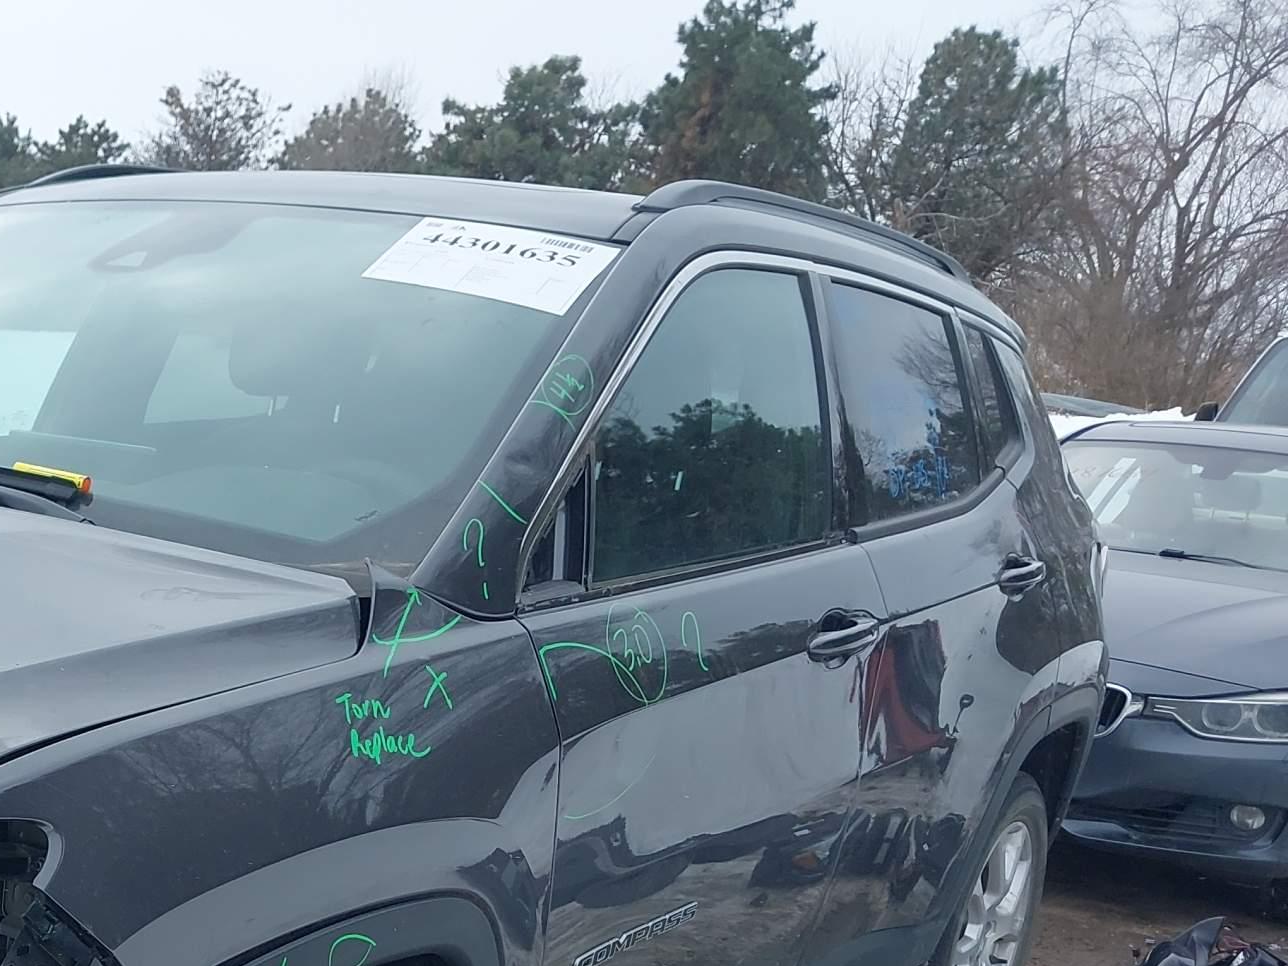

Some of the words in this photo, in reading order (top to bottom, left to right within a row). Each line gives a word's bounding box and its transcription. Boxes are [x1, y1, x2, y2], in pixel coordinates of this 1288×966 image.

[423, 232, 582, 268] 44301635
[335, 692, 392, 725] Torn
[349, 725, 432, 765] Replace
